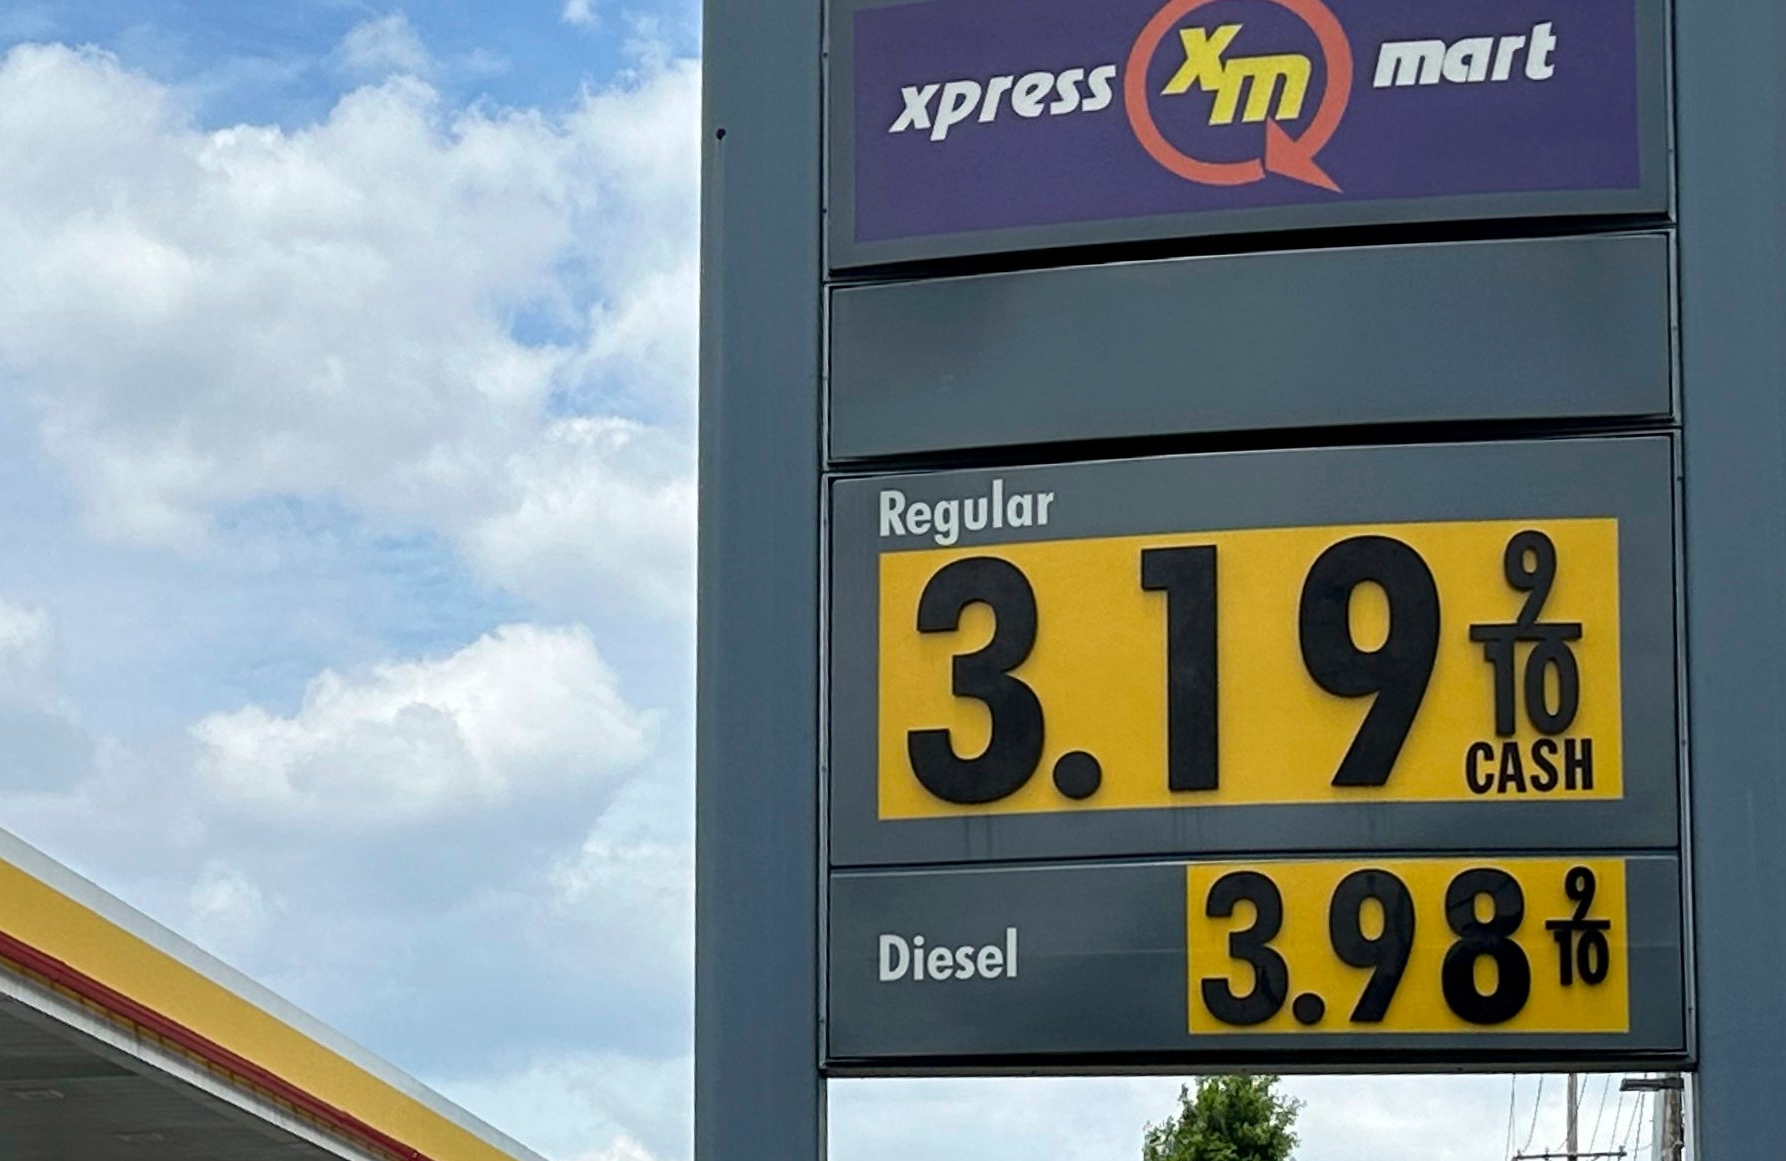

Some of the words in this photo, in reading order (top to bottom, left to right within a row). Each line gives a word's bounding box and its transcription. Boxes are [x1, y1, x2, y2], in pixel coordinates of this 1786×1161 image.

[889, 64, 1117, 140] xpress
[1373, 22, 1556, 90] mart
[878, 480, 1054, 545] Regular
[1466, 737, 1595, 796] CASH
[878, 927, 1019, 983] Diesel
[1199, 867, 1533, 1027] 3.98
